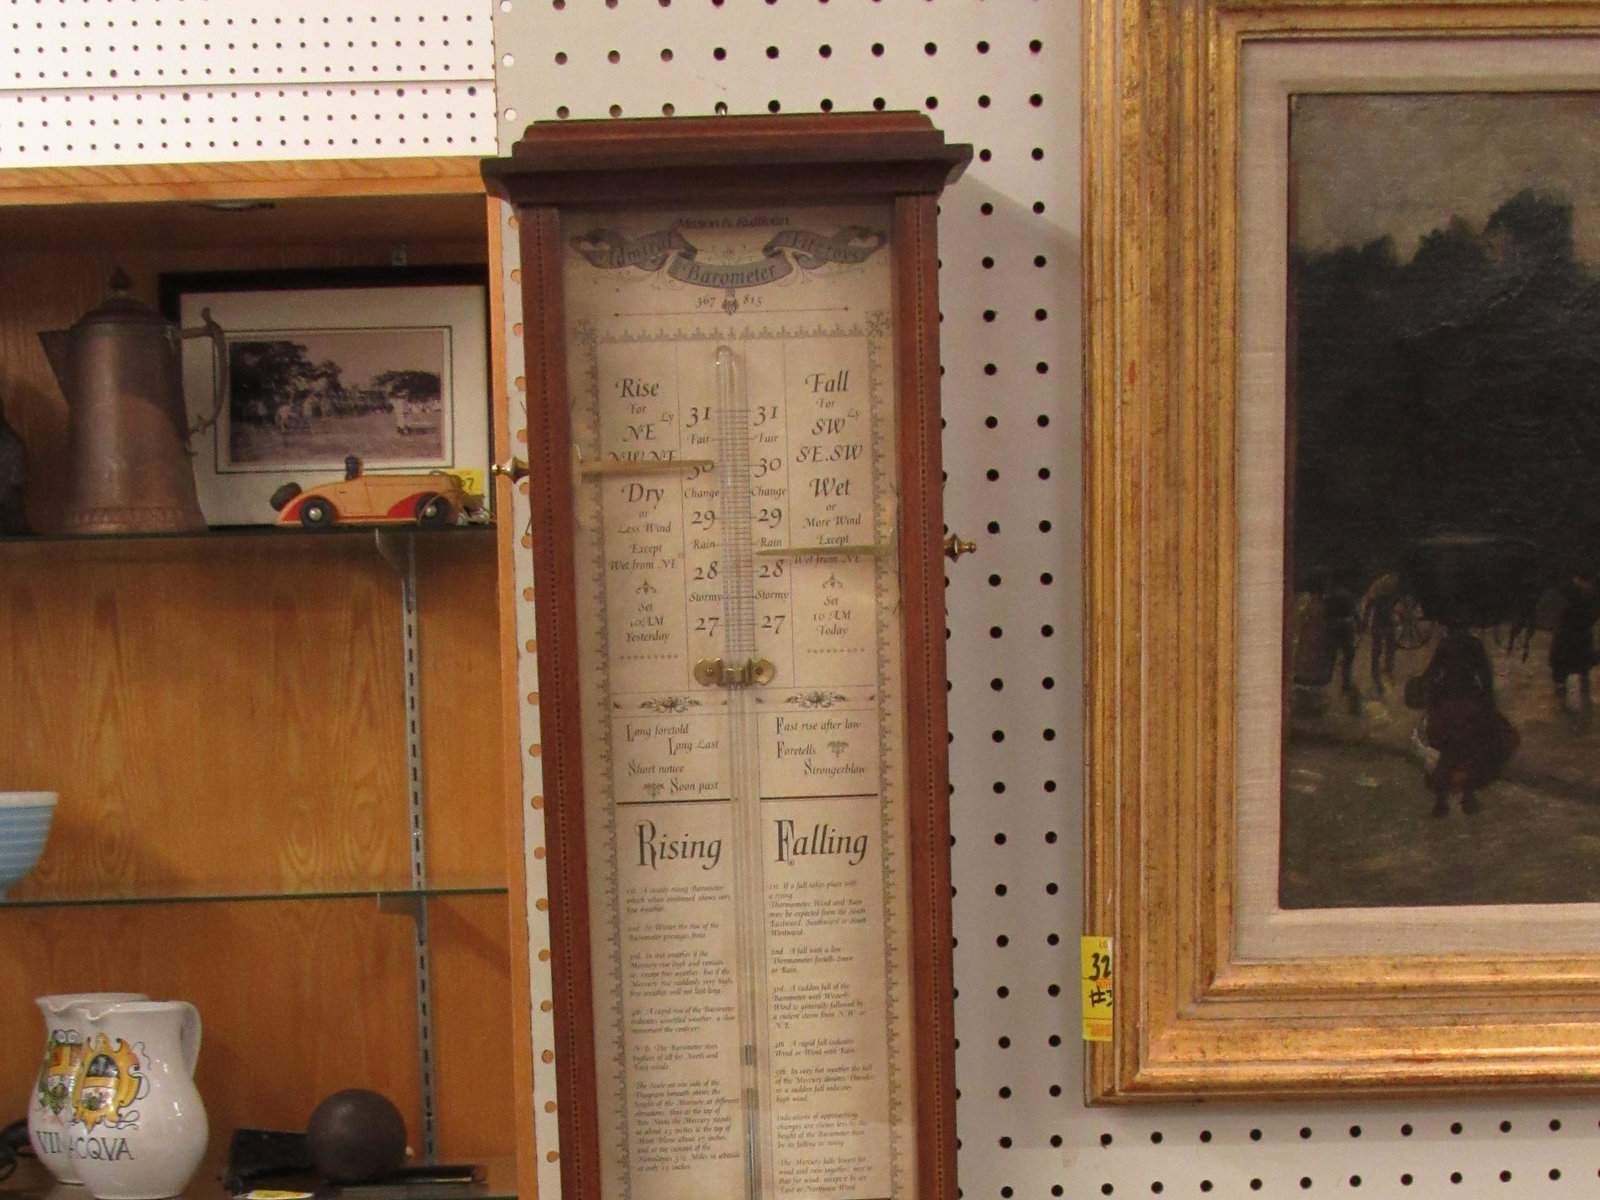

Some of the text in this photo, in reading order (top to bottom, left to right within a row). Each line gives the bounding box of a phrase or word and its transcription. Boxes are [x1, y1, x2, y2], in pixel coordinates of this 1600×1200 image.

[688, 263, 776, 286] Barometer
[615, 378, 660, 398] Rise
[805, 369, 849, 393] Fall
[629, 404, 647, 415] For
[686, 406, 711, 428] 31
[753, 405, 779, 427] 31
[622, 424, 657, 443] NE
[812, 418, 846, 436] SW
[687, 434, 711, 445] Fair
[755, 432, 779, 443] Fair
[755, 458, 782, 478] 30
[621, 482, 664, 510] Dry
[684, 488, 720, 500] Change
[752, 486, 787, 500] Change
[809, 477, 851, 497] Wet
[825, 503, 837, 512] or
[645, 521, 672, 533] Wind
[691, 510, 716, 531] 29
[758, 508, 782, 529] 29
[802, 514, 862, 529] More Wind
[631, 544, 663, 556] Except
[692, 538, 716, 550] Rain
[758, 536, 782, 548] Rain
[816, 535, 849, 547] Except
[631, 559, 654, 573] from
[759, 559, 784, 578] 28
[816, 555, 838, 567] from
[693, 561, 718, 580] 28
[689, 592, 723, 605] Stormy
[755, 590, 789, 603] Stormy
[823, 596, 839, 607] Set
[638, 601, 653, 612] Set
[695, 617, 720, 637] 27
[761, 615, 786, 635] 27
[816, 624, 849, 639] Today
[625, 630, 671, 645] Yesterday
[626, 723, 689, 742] Long foretold
[776, 717, 798, 735] Fast
[801, 722, 818, 731] rise
[821, 719, 842, 734] after
[668, 738, 693, 756] Long
[777, 741, 817, 759] Foretells
[628, 760, 684, 776] Short notice
[670, 777, 719, 794] Soon past
[634, 819, 722, 871] Rising
[774, 819, 868, 867] Falling
[1089, 952, 1112, 981] 32
